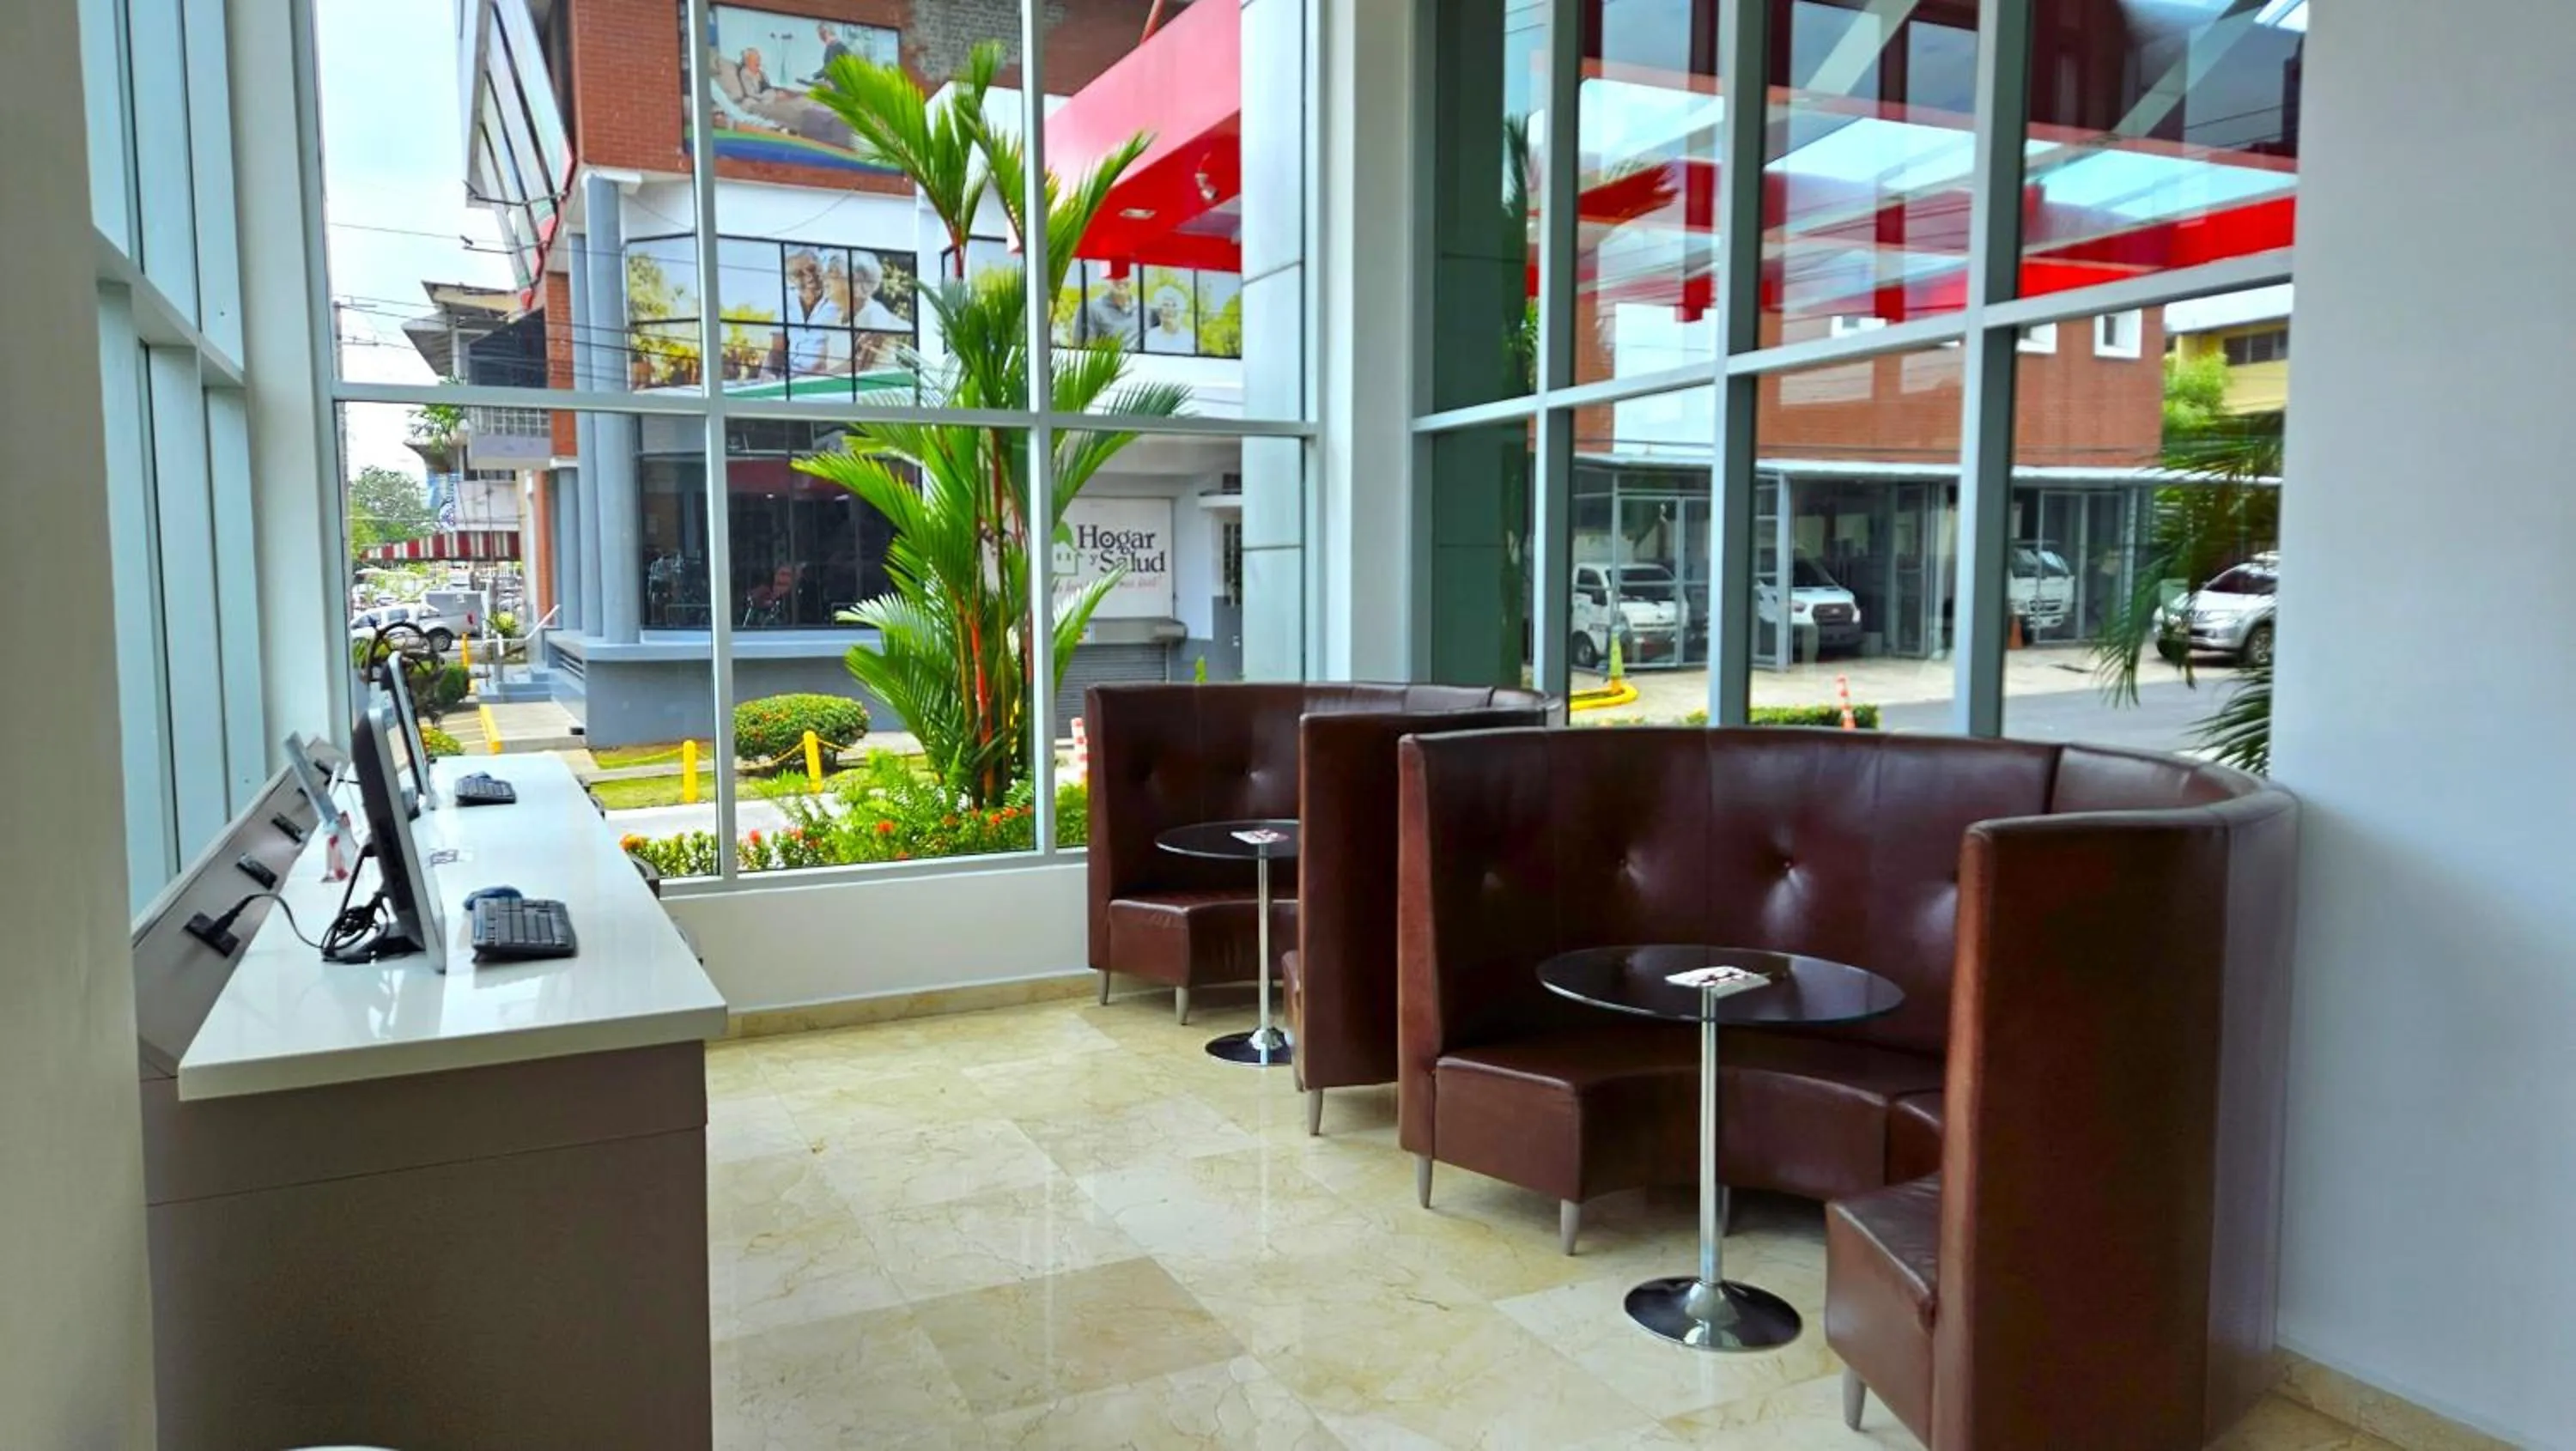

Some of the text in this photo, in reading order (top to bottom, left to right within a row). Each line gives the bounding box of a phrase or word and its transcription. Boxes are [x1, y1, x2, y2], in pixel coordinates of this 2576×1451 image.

[1077, 524, 1157, 555] Hogar
[1090, 549, 1165, 574] y Salud
